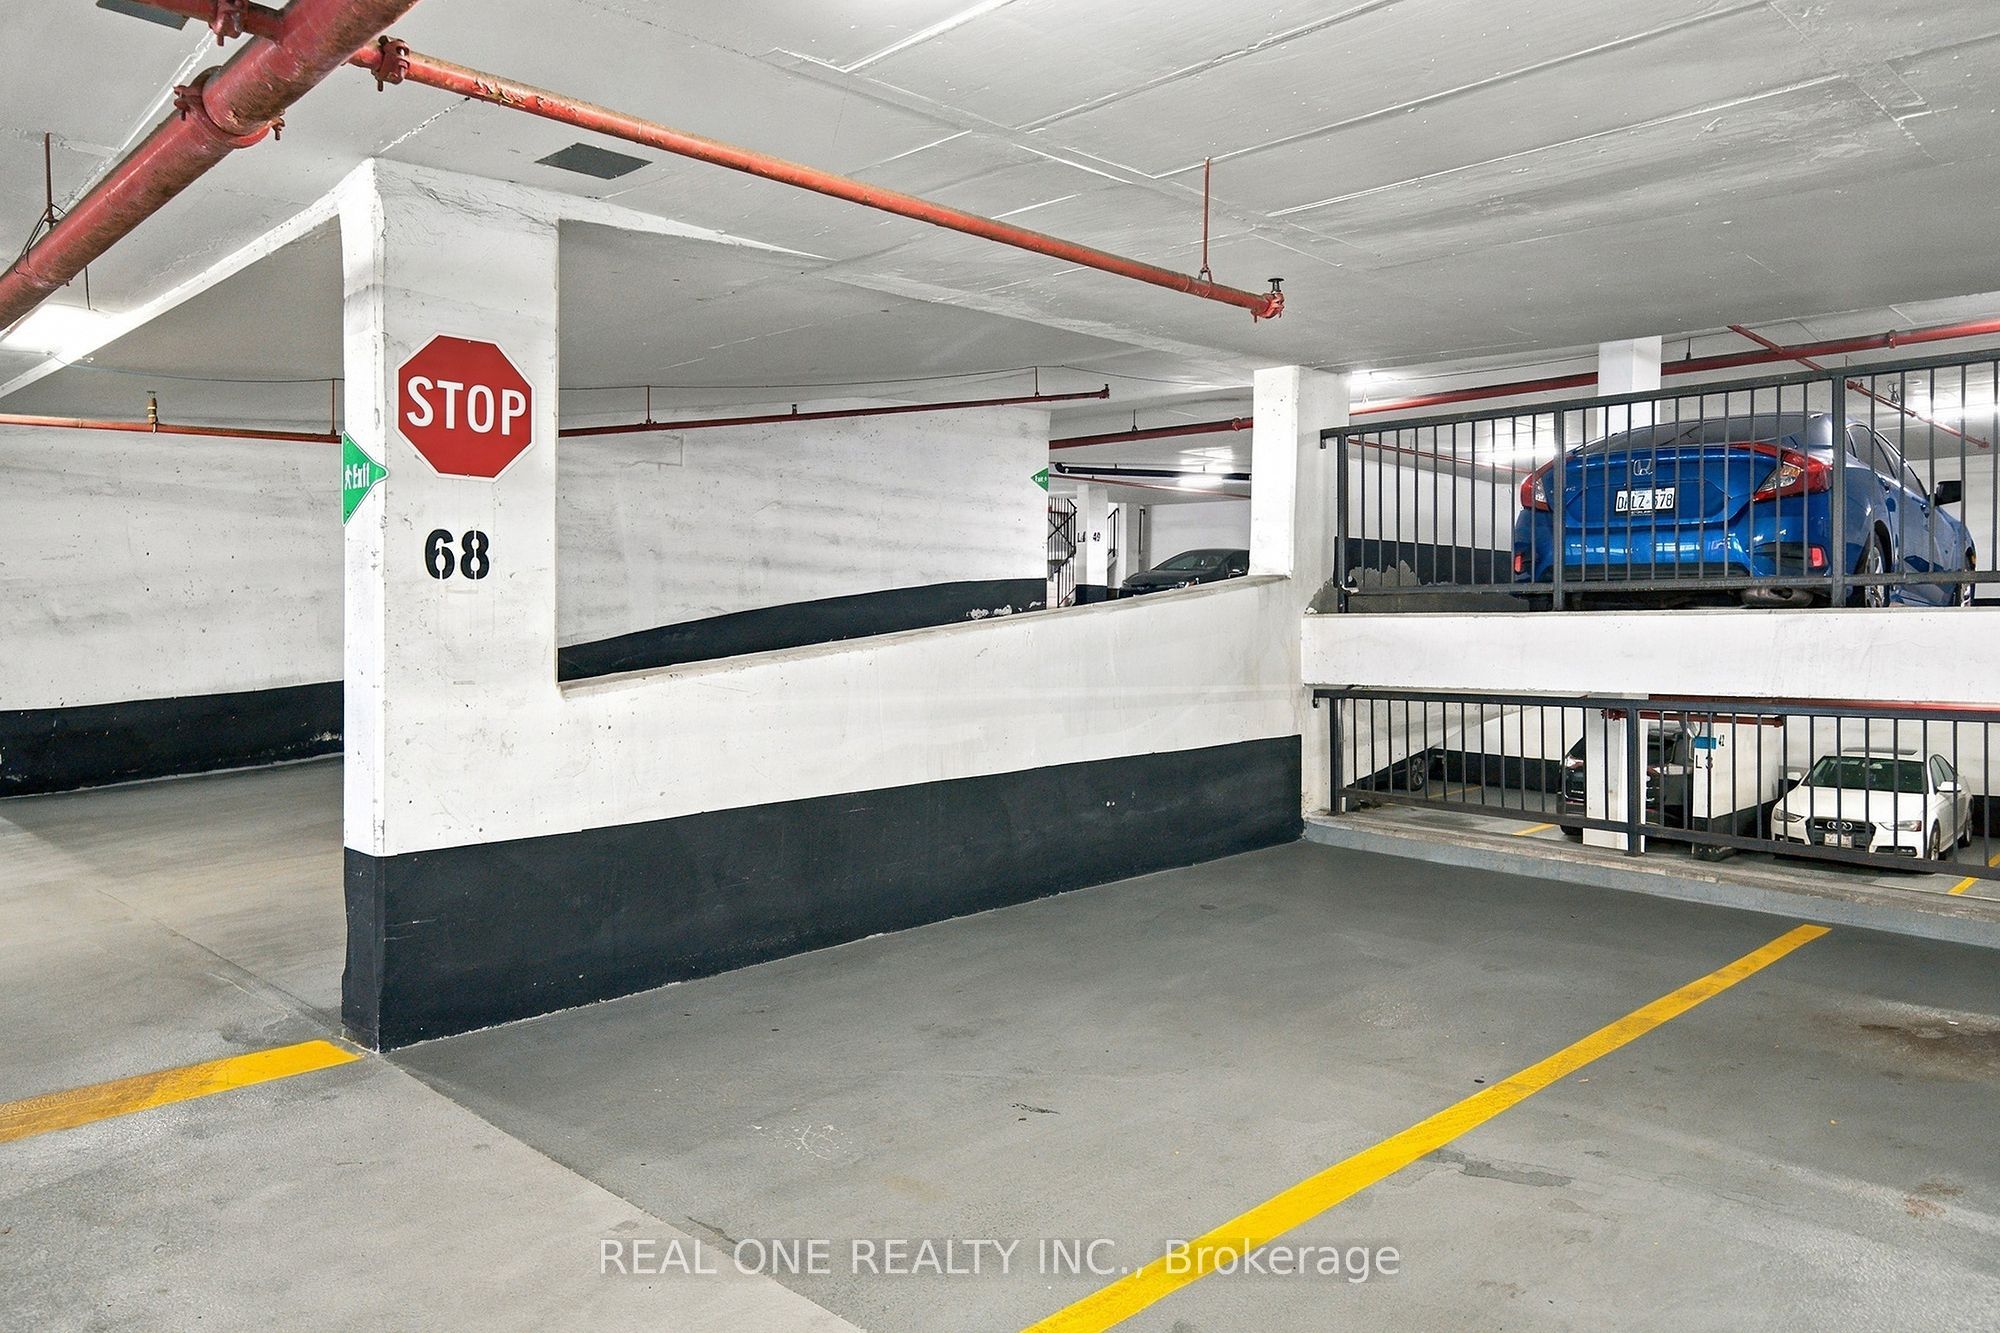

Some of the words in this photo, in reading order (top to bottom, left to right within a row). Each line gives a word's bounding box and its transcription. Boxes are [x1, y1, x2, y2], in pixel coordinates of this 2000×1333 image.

[406, 375, 527, 436] STOP
[352, 462, 370, 490] Exit
[424, 528, 490, 580] 68
